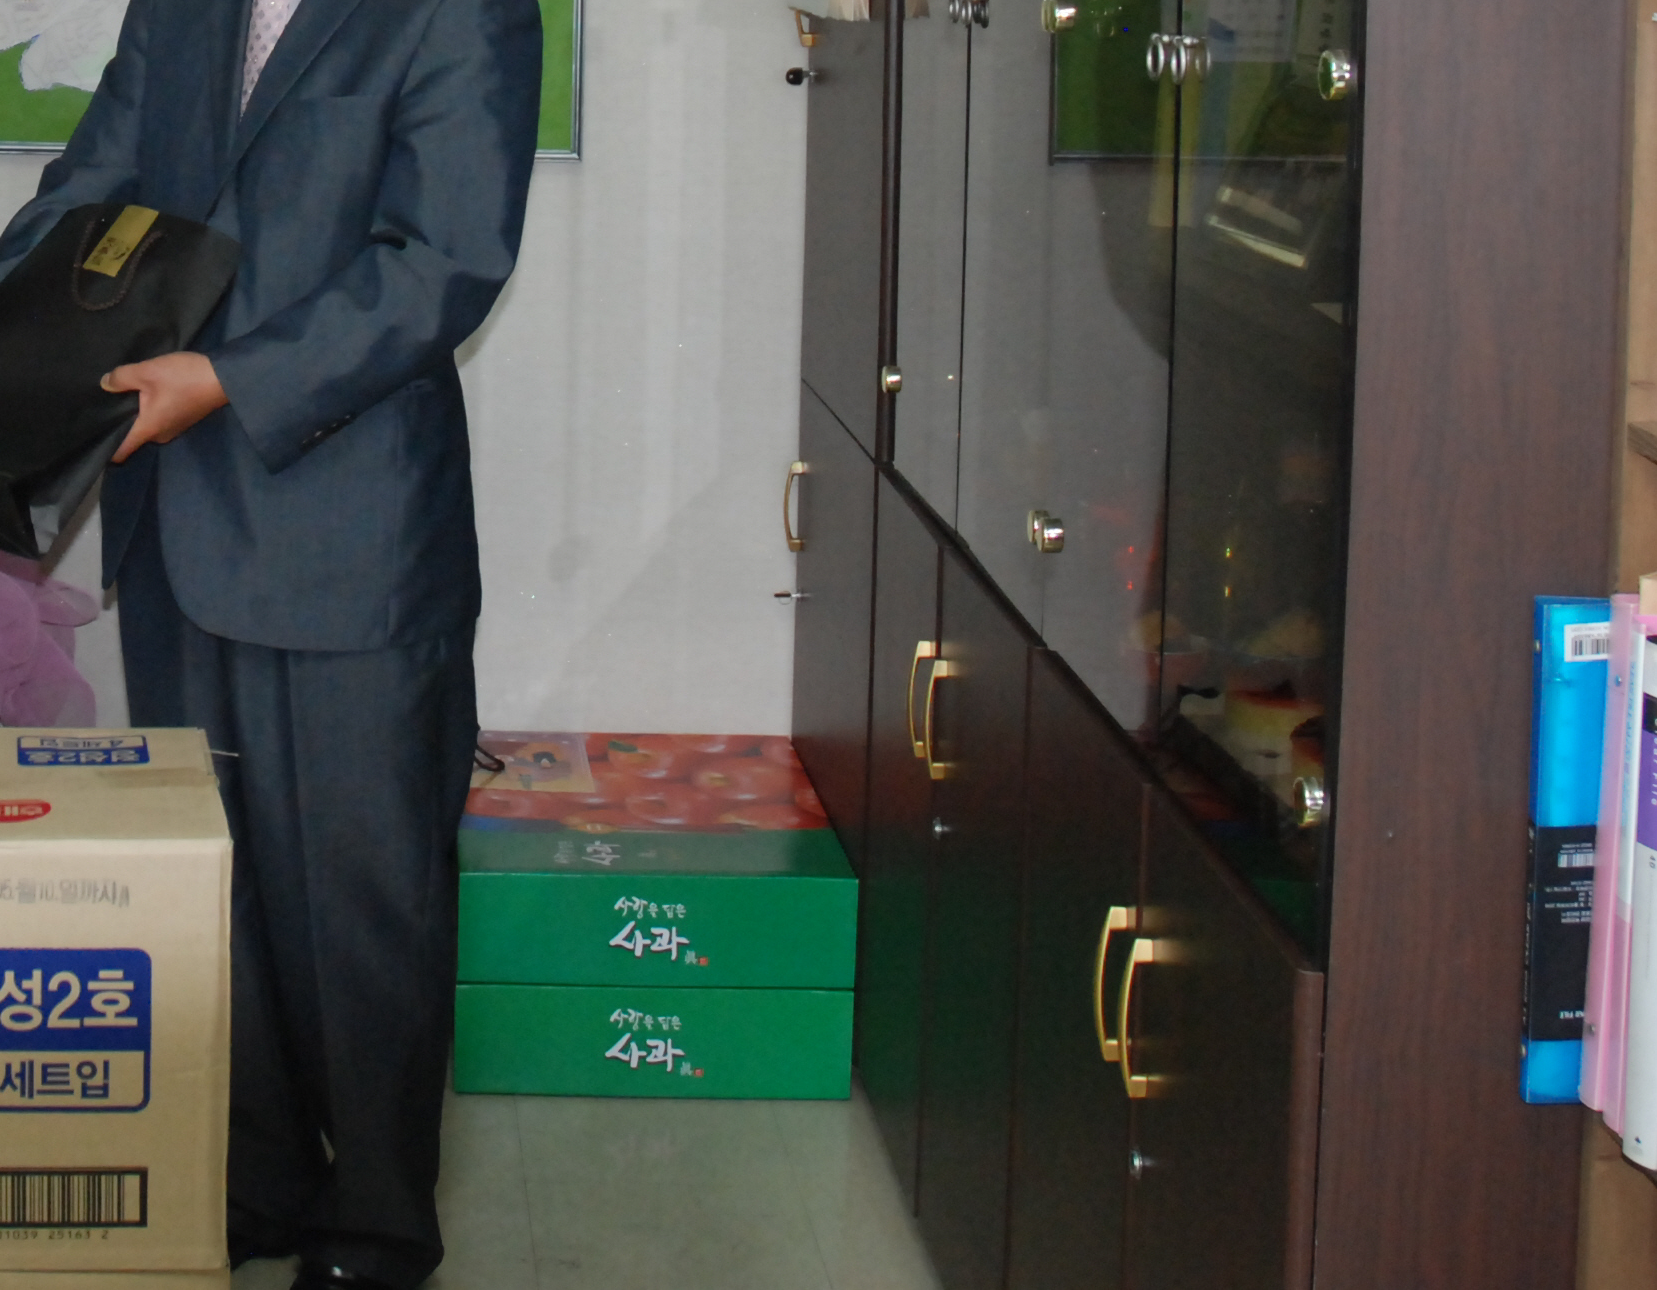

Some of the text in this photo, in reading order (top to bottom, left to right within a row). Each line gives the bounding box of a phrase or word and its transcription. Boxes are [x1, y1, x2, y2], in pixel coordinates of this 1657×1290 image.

[27, 750, 142, 764] 정성2호
[614, 896, 658, 918] 사랑을
[609, 921, 690, 960] 사과
[610, 1009, 653, 1030] 사랑을
[605, 1033, 685, 1072] 사과
[0, 1059, 111, 1100] 세트입
